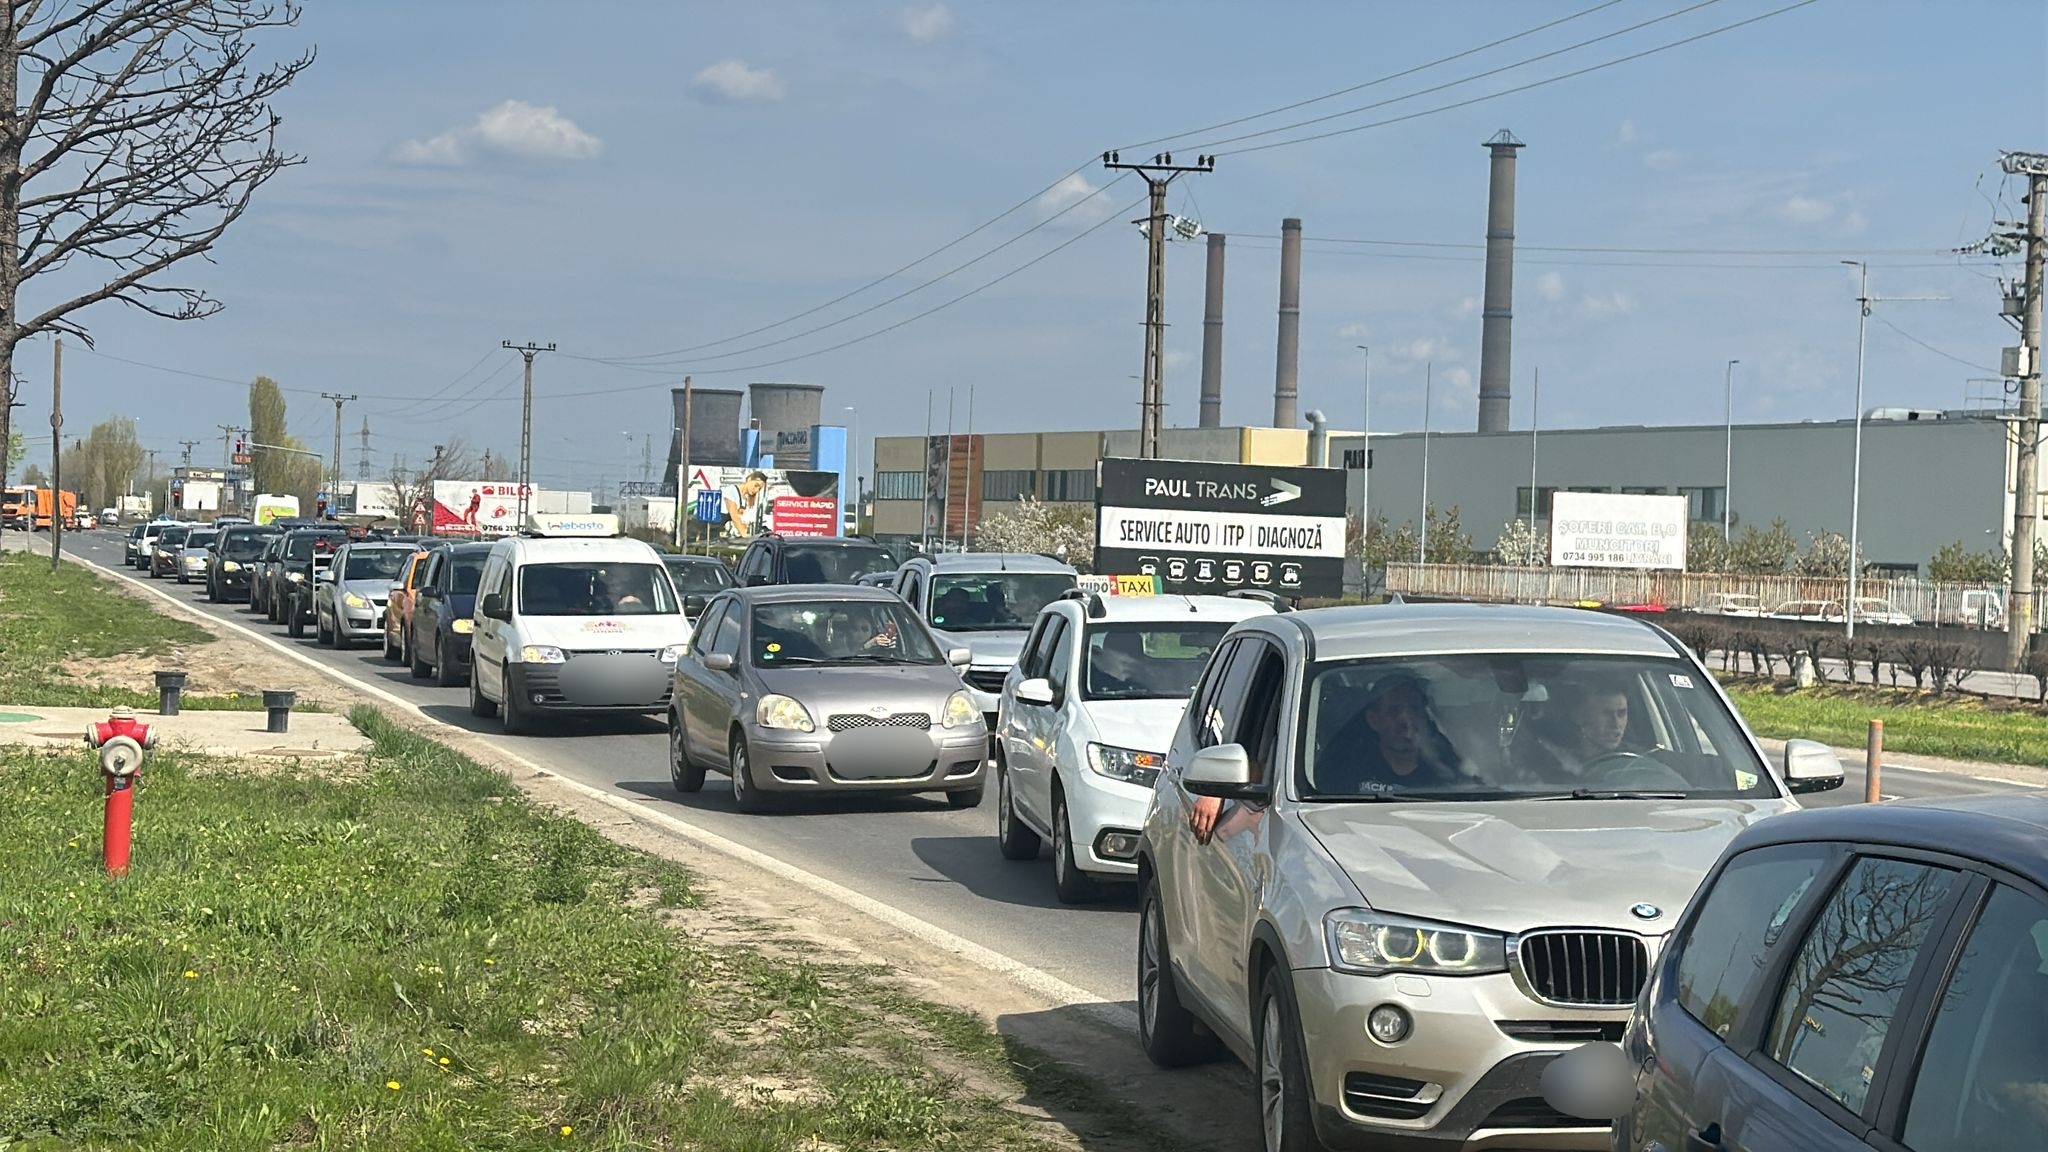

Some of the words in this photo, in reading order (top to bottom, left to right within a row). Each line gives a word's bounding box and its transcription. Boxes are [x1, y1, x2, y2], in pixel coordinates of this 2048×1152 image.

[1144, 478, 1191, 498] PAUL
[1196, 480, 1257, 499] TRANS
[776, 500, 809, 508] SERVICE
[810, 501, 835, 510] RAPID
[1120, 519, 1173, 543] SERVICE
[1175, 521, 1210, 545] AUTO
[1223, 524, 1245, 547] ITP
[1257, 523, 1323, 550] DIAGNOZĂ
[1575, 537, 1660, 553] MUNCITORI
[1562, 551, 1585, 561] 0734
[1588, 552, 1605, 562] 995
[1608, 553, 1624, 563] 186
[1119, 581, 1151, 593] TAXI
